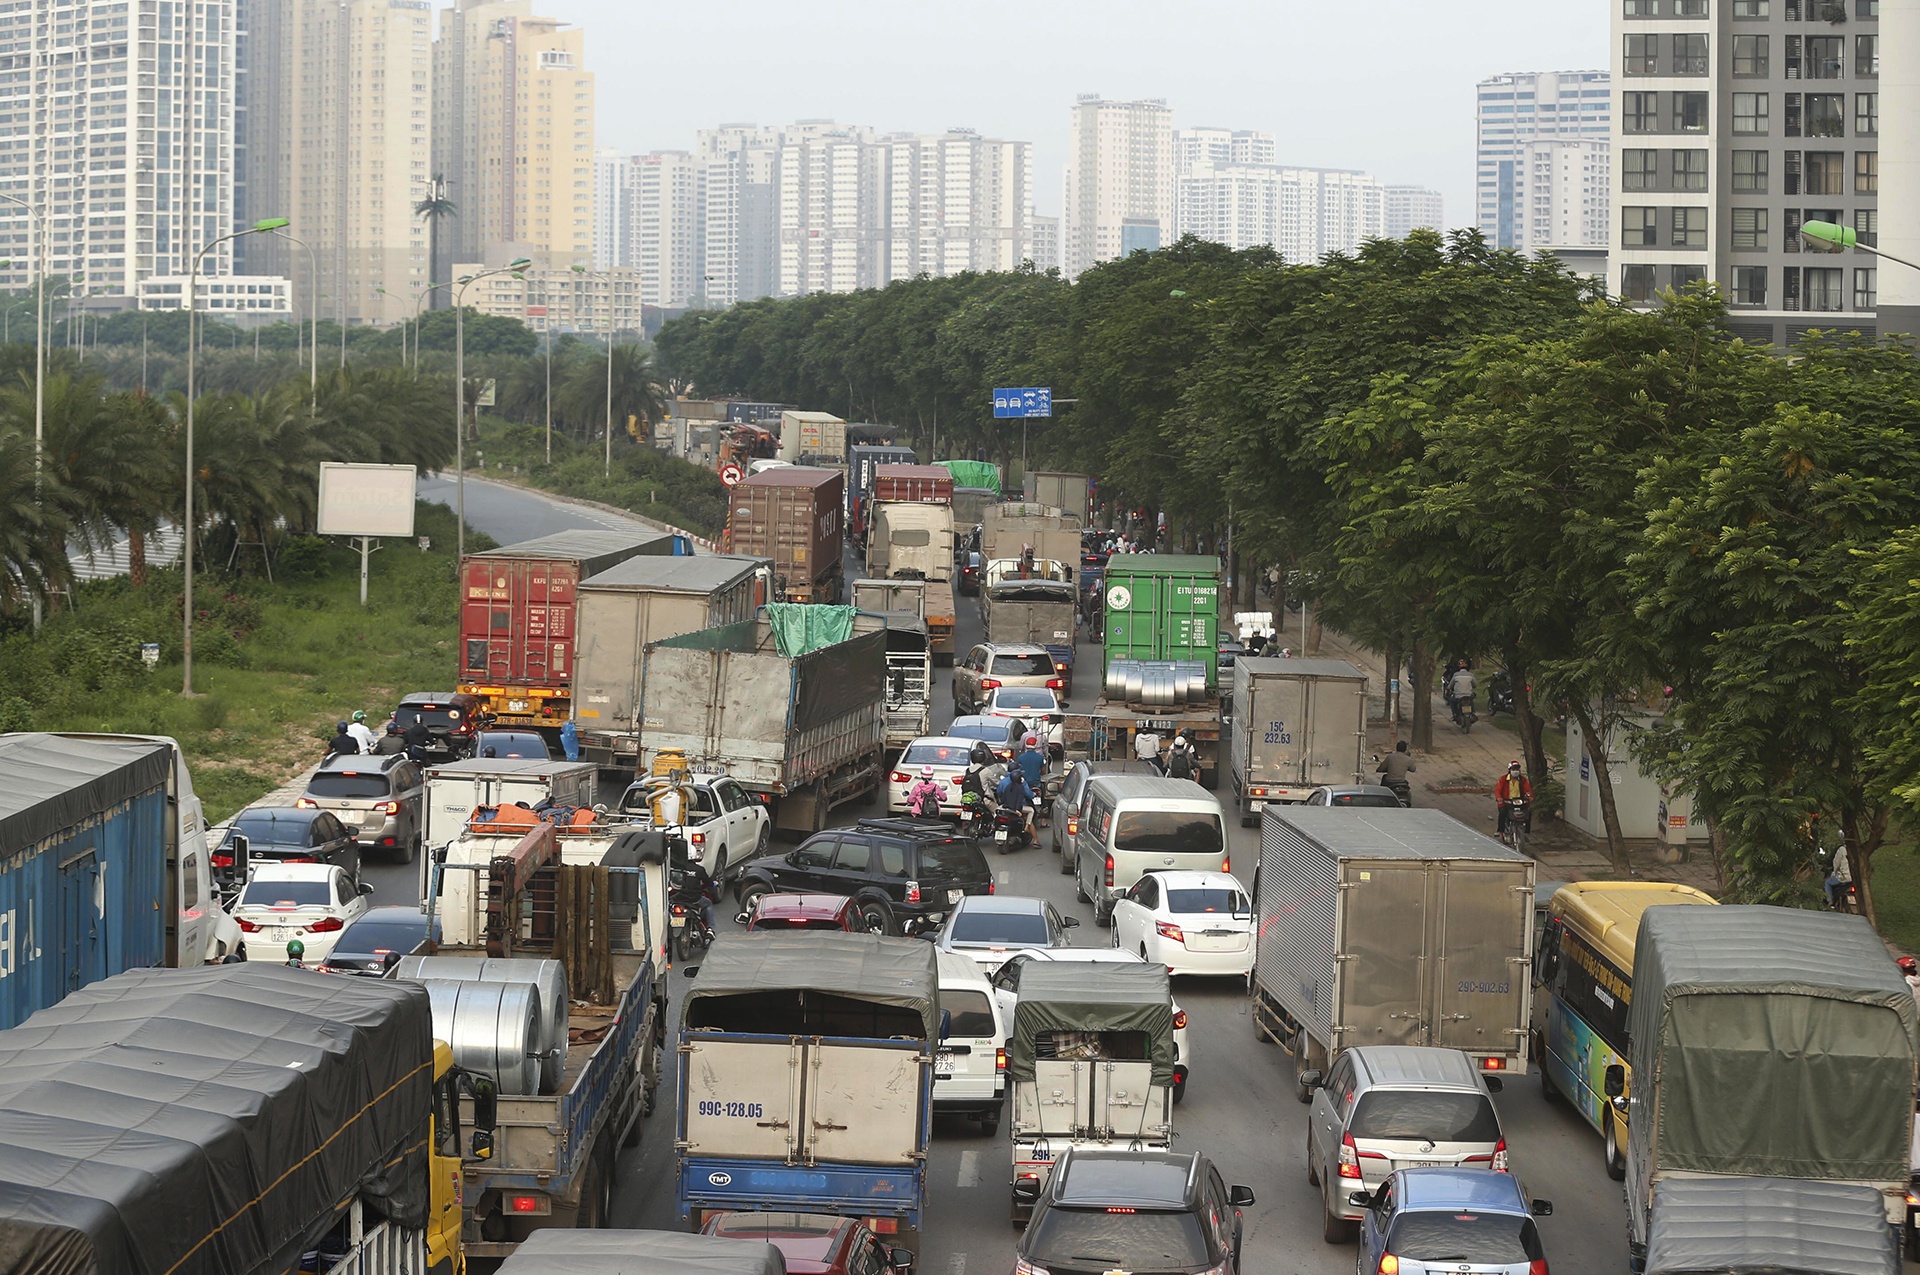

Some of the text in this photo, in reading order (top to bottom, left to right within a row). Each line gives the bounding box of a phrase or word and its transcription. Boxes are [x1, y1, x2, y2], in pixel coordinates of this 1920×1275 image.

[1270, 722, 1284, 733] 15C
[1264, 733, 1291, 744] 232.63
[1458, 981, 1510, 993] 29C-902.63
[698, 1101, 763, 1118] 99C-128.05
[711, 1175, 730, 1183] TMT
